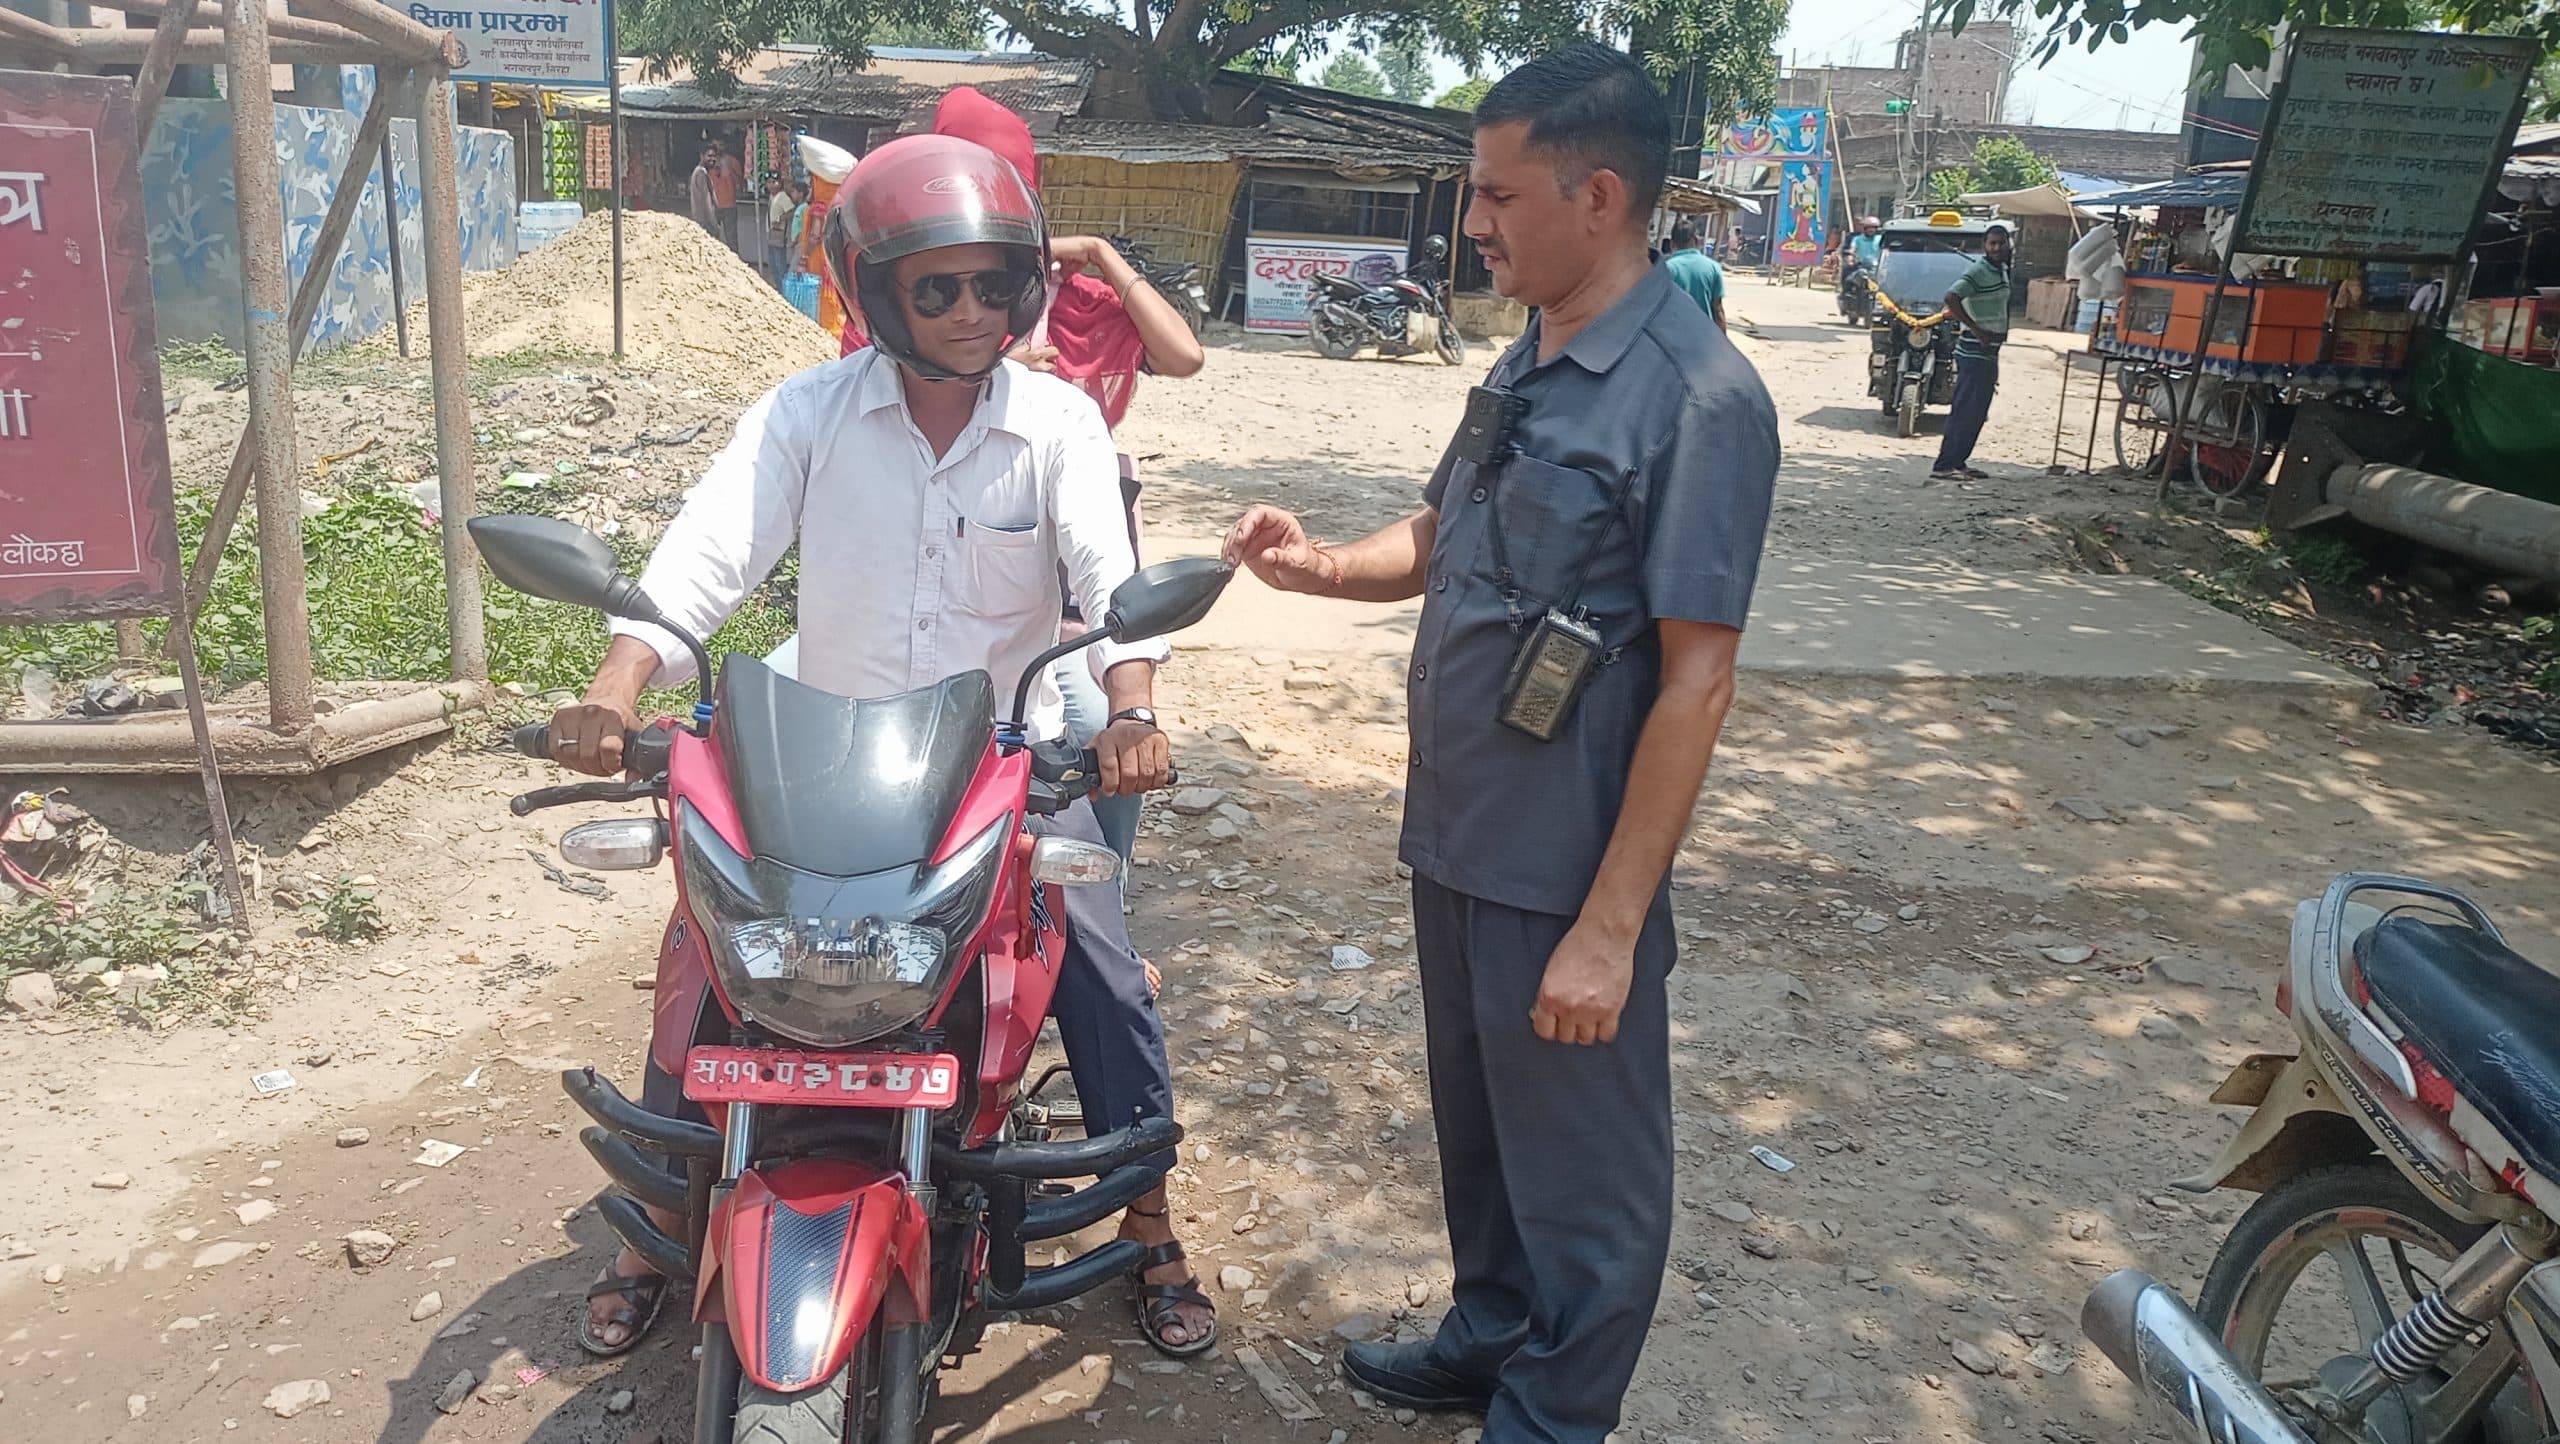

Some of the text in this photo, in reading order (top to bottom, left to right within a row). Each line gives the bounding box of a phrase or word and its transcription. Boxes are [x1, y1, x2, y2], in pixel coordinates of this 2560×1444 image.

[408, 3, 569, 34] सिमा प्रारम्भ
[2355, 45, 2417, 71] भगवानपुर
[2345, 72, 2401, 96] स्वागत
[2316, 201, 2377, 222] धन्यवाद
